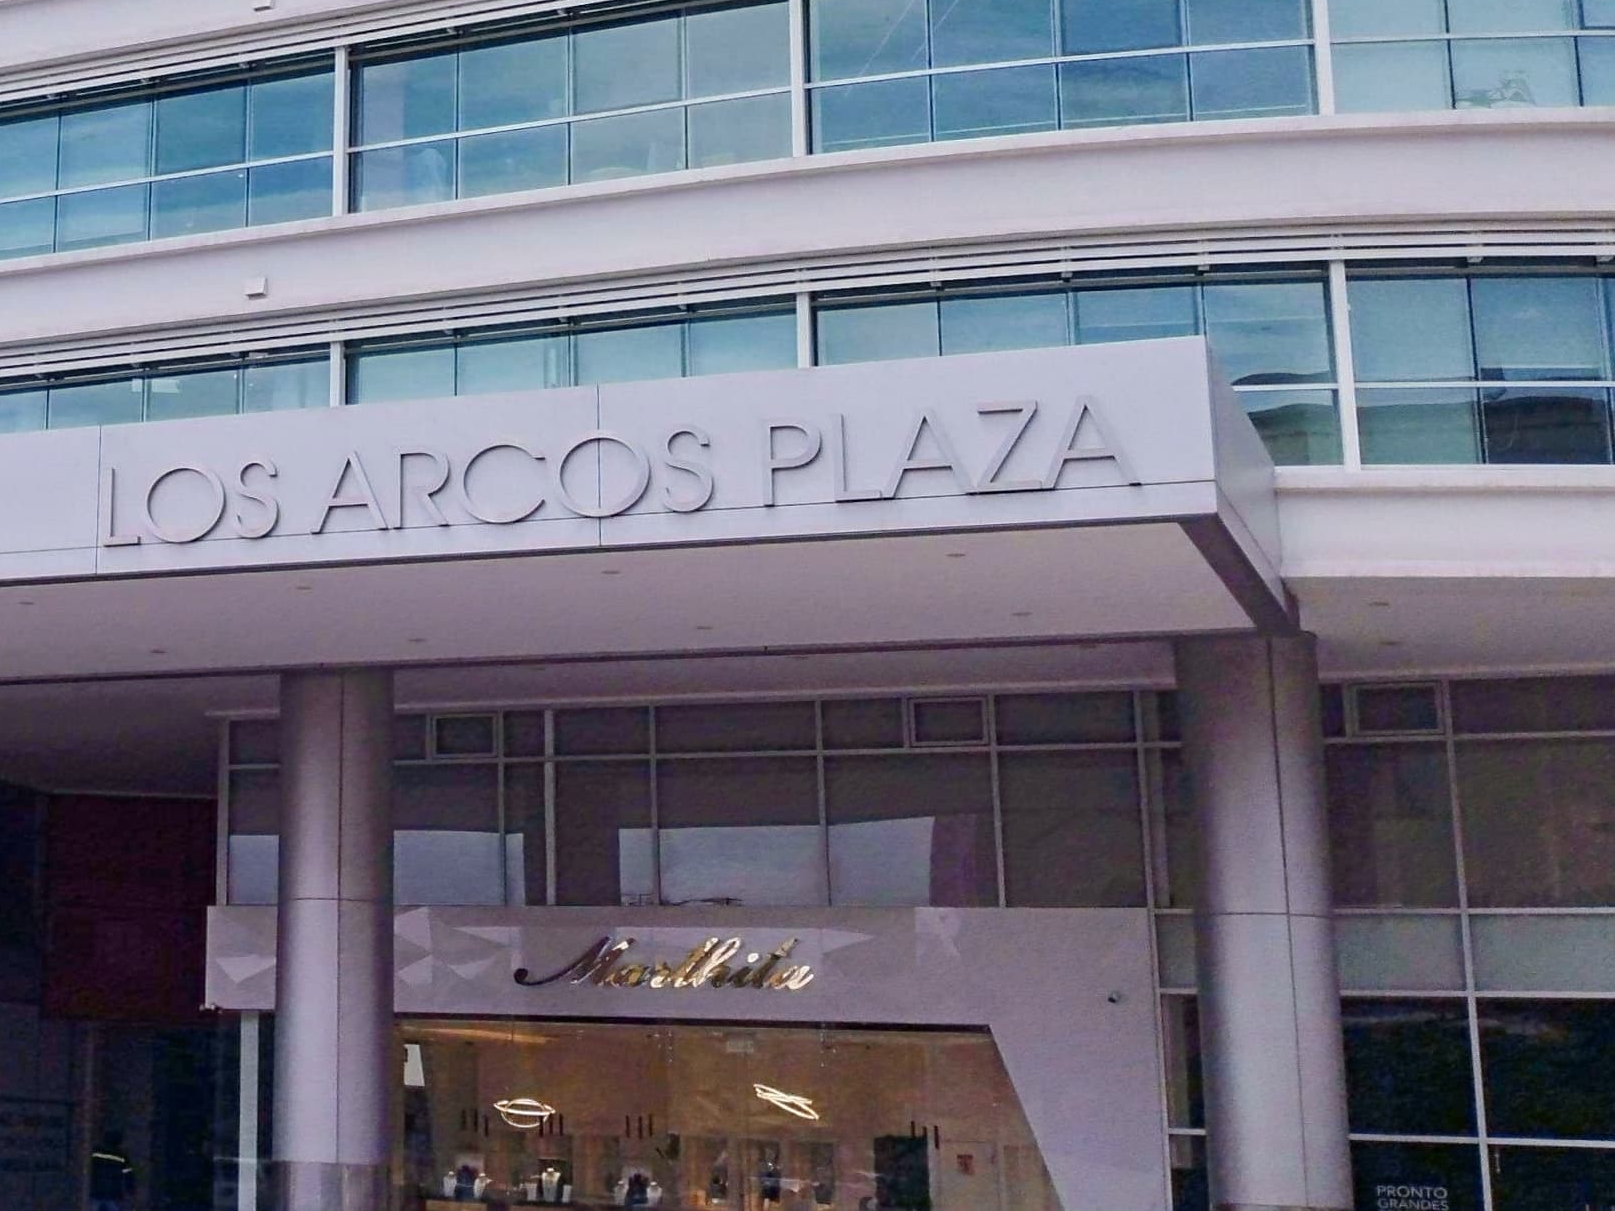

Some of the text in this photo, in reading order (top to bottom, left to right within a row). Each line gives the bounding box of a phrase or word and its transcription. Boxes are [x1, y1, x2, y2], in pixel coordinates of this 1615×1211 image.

[103, 395, 1143, 547] LOS ARCOS PLAZA
[1376, 1185, 1448, 1199] PRONTO
[1376, 1198, 1450, 1211] GRANDES
